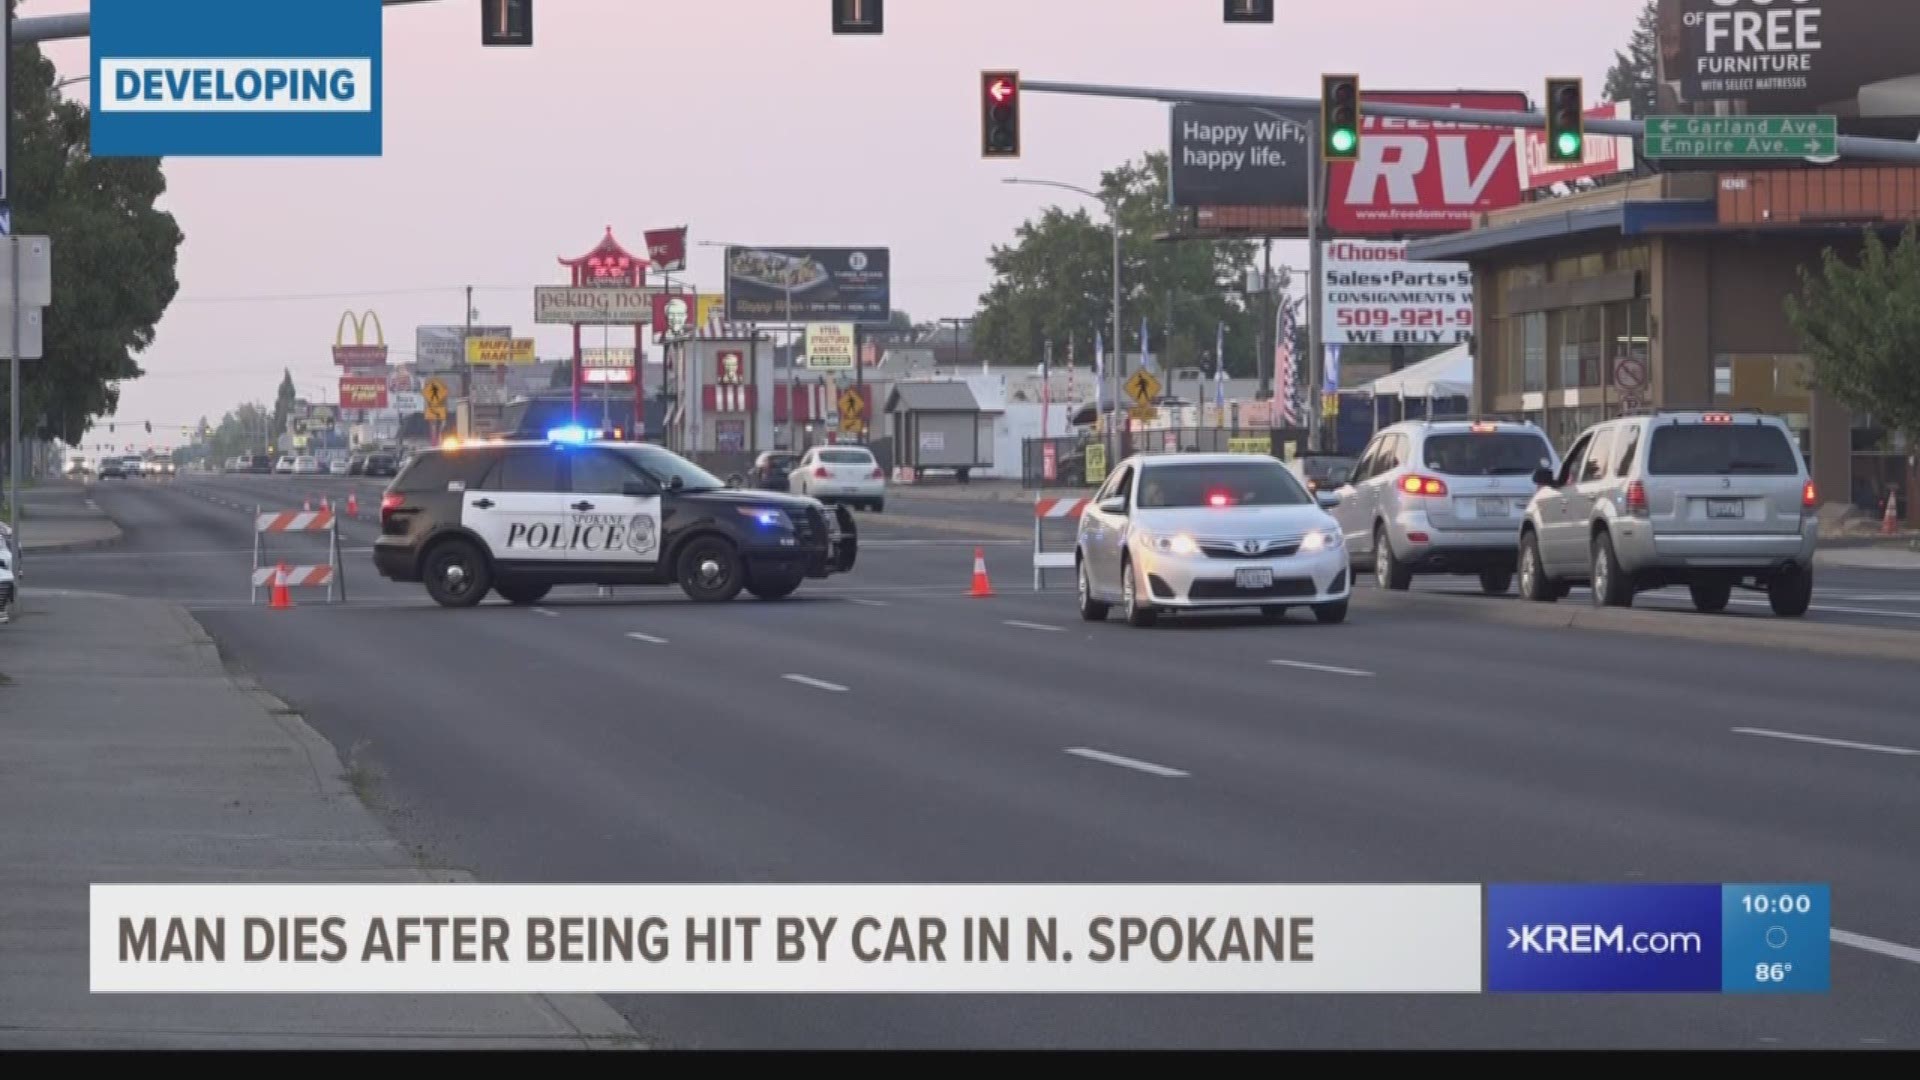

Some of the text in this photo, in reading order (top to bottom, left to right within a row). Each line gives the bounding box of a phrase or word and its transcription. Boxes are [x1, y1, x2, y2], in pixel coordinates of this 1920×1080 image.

[1683, 8, 1822, 53] OF FREE
[1697, 54, 1811, 73] FURNITURE
[1702, 77, 1807, 91] WITH SELECT MATTRESSES
[1183, 120, 1305, 145] Happy WiFi,
[1687, 119, 1823, 133] Garland Ave.
[1661, 138, 1788, 155] Empire Ave.
[1183, 146, 1286, 171] happy life.
[1343, 135, 1516, 205] RV
[1328, 292, 1456, 303] CONSIGNMENTS
[819, 325, 841, 335] STEEL
[1346, 330, 1383, 343] WE
[1393, 330, 1444, 343] BUY
[479, 340, 532, 350] MUFFLER
[812, 346, 848, 354] AMERICA
[571, 514, 625, 525] SPOKANE
[506, 522, 626, 551] POLICE
